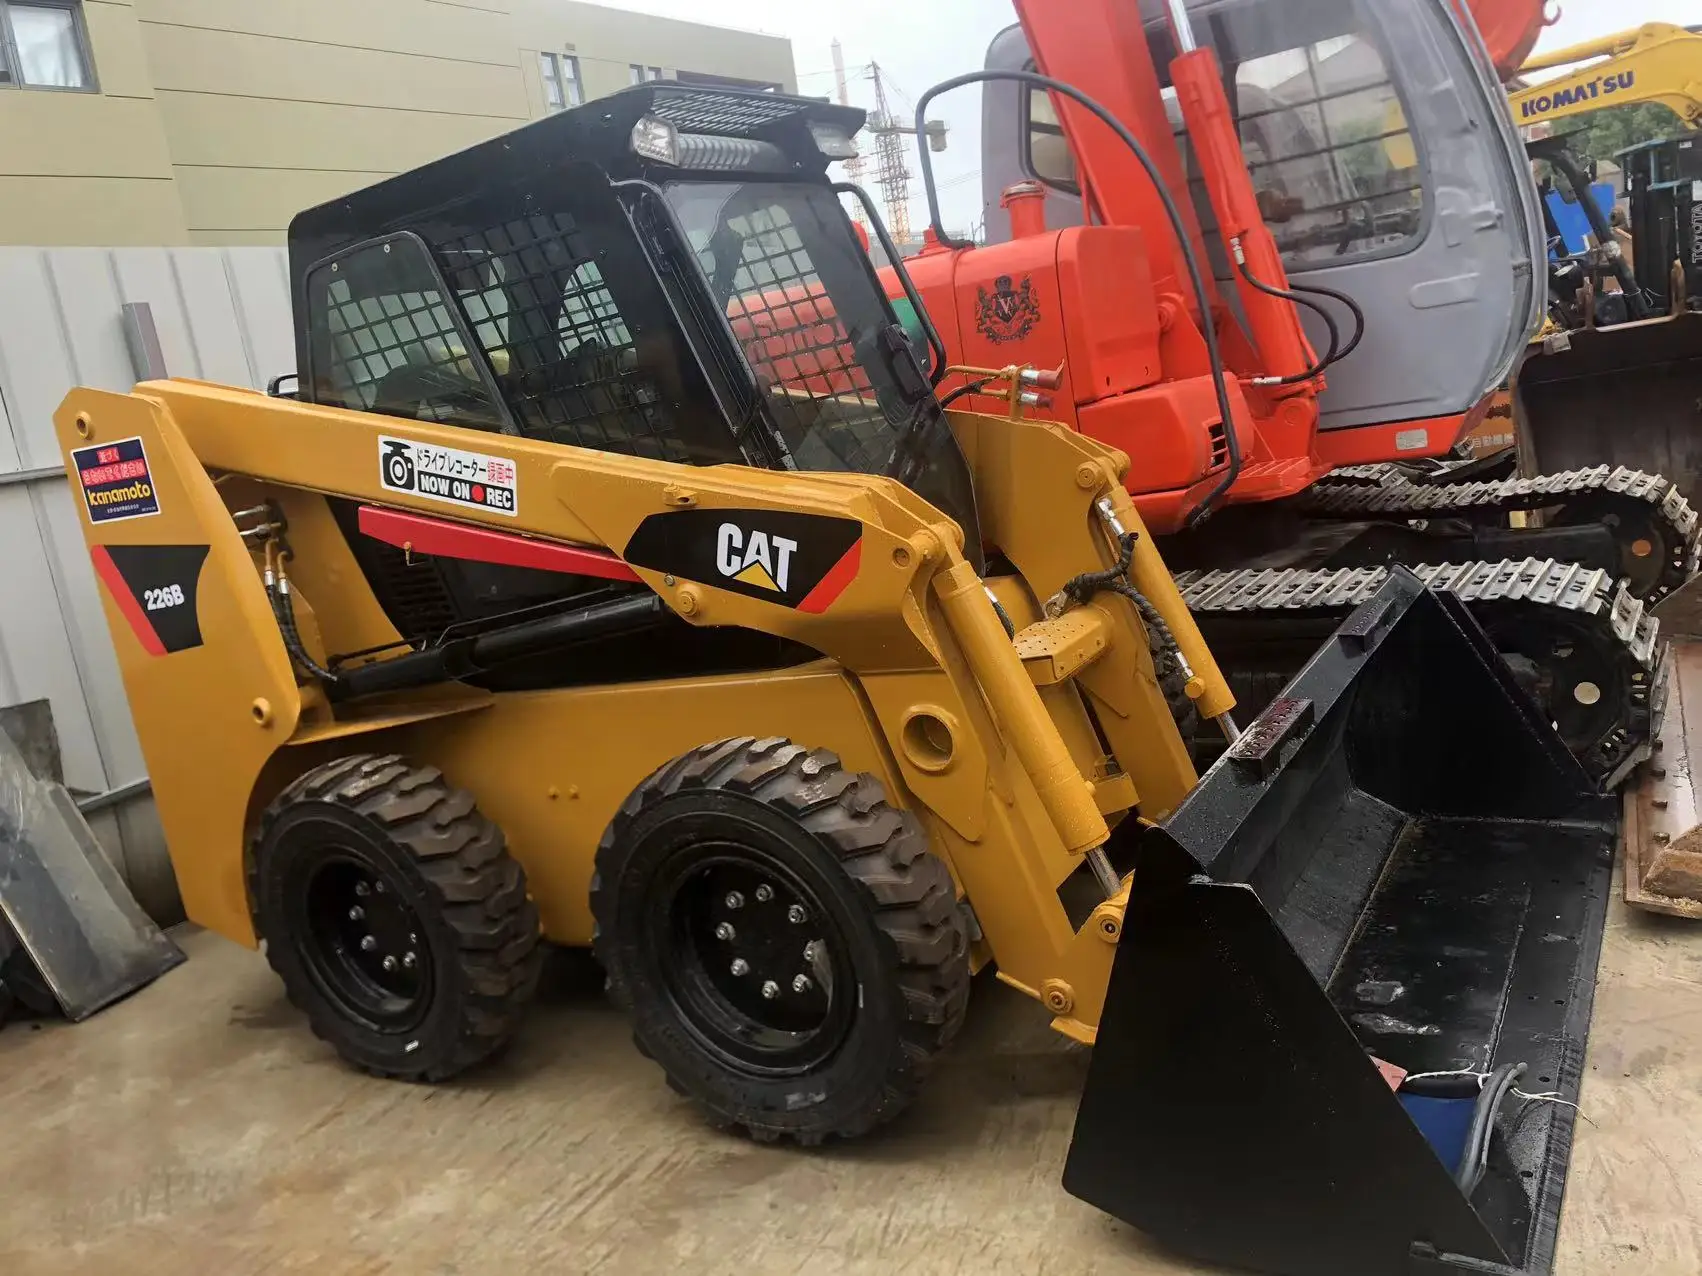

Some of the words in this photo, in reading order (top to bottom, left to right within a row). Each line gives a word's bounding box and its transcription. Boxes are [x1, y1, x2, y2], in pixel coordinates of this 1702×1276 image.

[1521, 71, 1634, 117] KOMATSU
[87, 480, 151, 506] kanamoto
[420, 473, 451, 496] NOW
[452, 481, 470, 500] ON
[486, 487, 513, 509] REC
[716, 522, 797, 593] CAT
[144, 583, 185, 611] 226B
